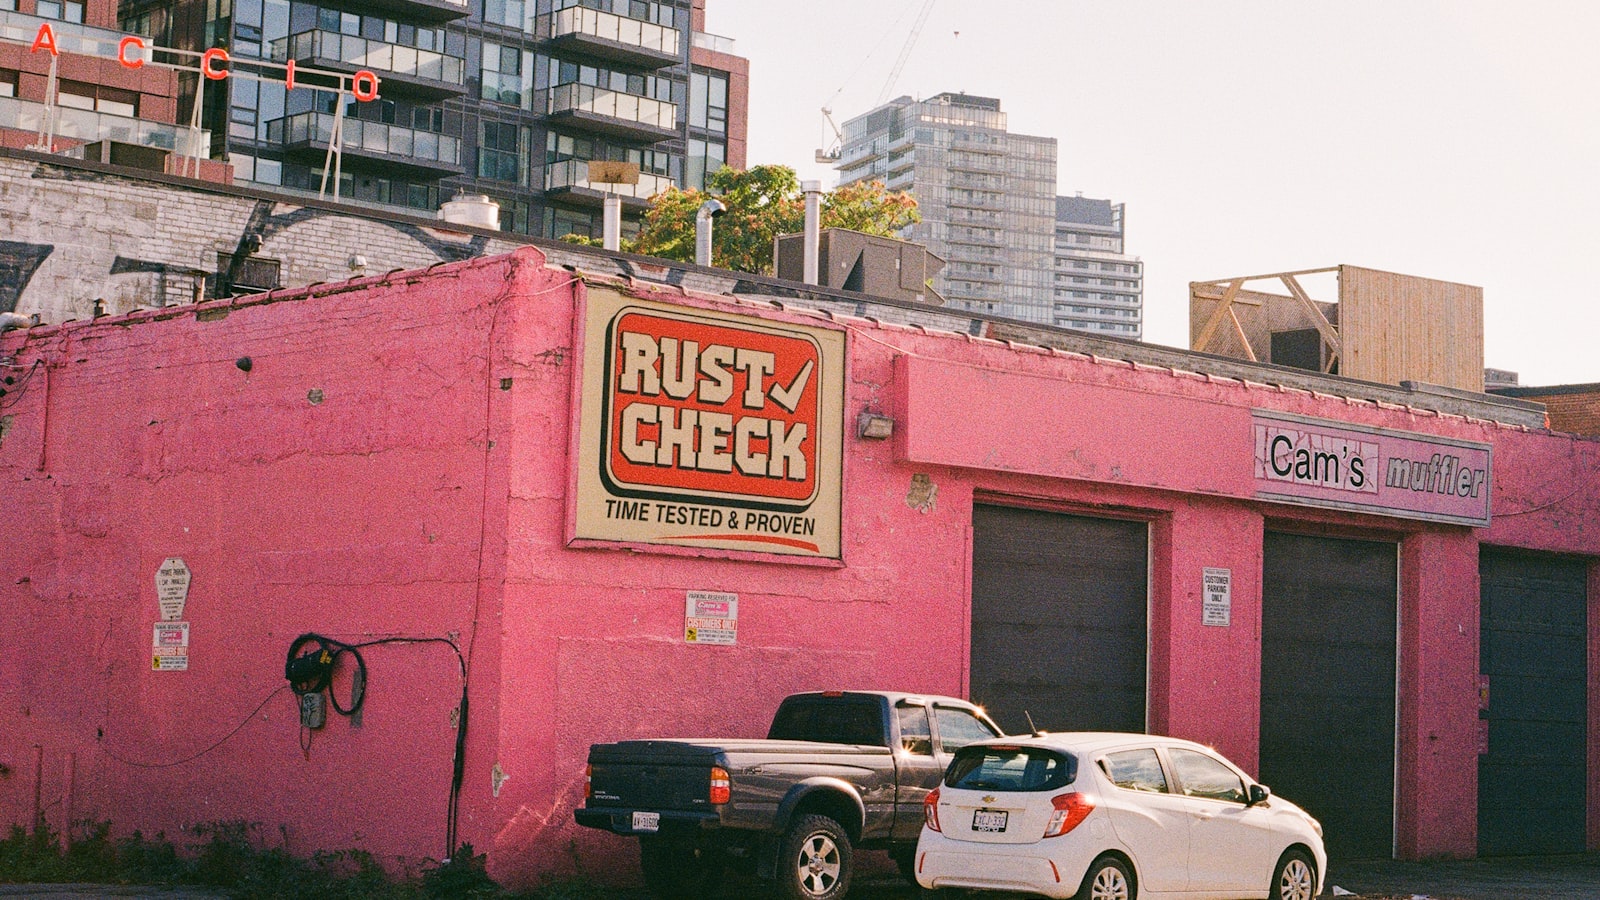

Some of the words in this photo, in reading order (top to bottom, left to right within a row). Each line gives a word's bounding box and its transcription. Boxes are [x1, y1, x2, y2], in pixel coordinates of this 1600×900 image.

[31, 23, 379, 102] ACCIO
[618, 331, 775, 410] RUST
[619, 402, 808, 482] CHECK
[1270, 434, 1365, 488] Cam's
[1385, 453, 1485, 498] muffler
[605, 499, 650, 522] TIME
[656, 504, 722, 528] TESTED
[728, 512, 739, 530] &
[745, 515, 815, 536] PROVEN
[1205, 575, 1229, 585] CUSTOMER
[1207, 584, 1227, 594] PARKING
[1211, 594, 1223, 602] ONLY
[687, 617, 722, 629] CUSTOMERS
[723, 619, 736, 630] ONLY
